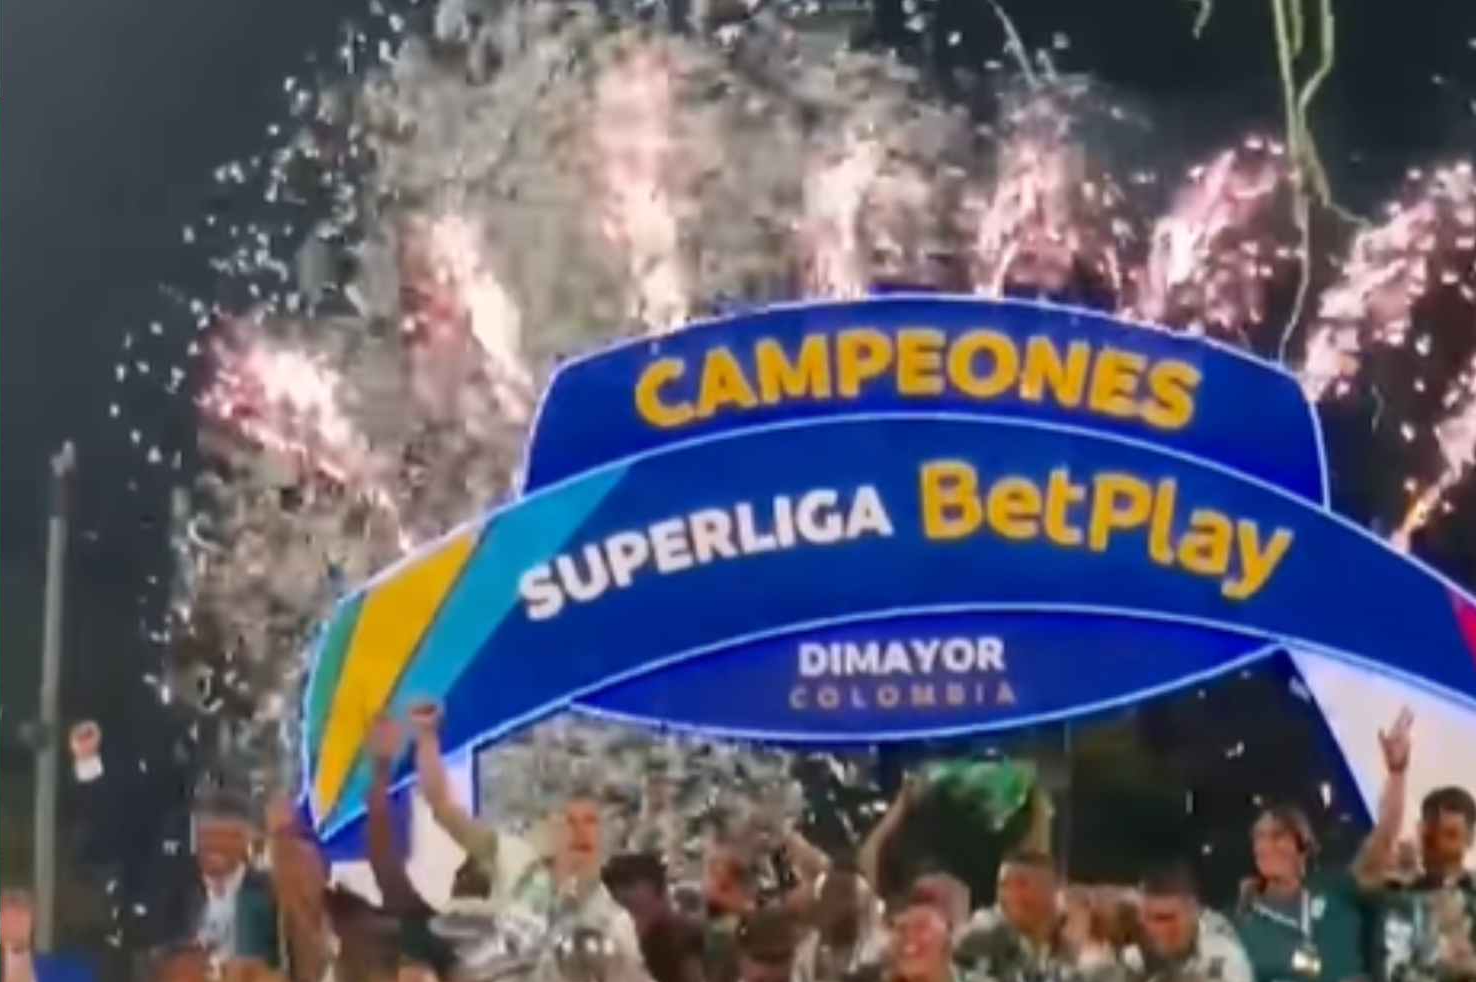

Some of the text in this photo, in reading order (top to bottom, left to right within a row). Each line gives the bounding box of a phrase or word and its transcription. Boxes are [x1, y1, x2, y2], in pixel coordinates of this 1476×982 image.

[635, 328, 1202, 429] CAMPEONES
[519, 459, 1294, 620] SUPERLIGA BetPlay
[798, 636, 1007, 677] DIMAYOR
[788, 682, 1016, 709] COLOMBIA
